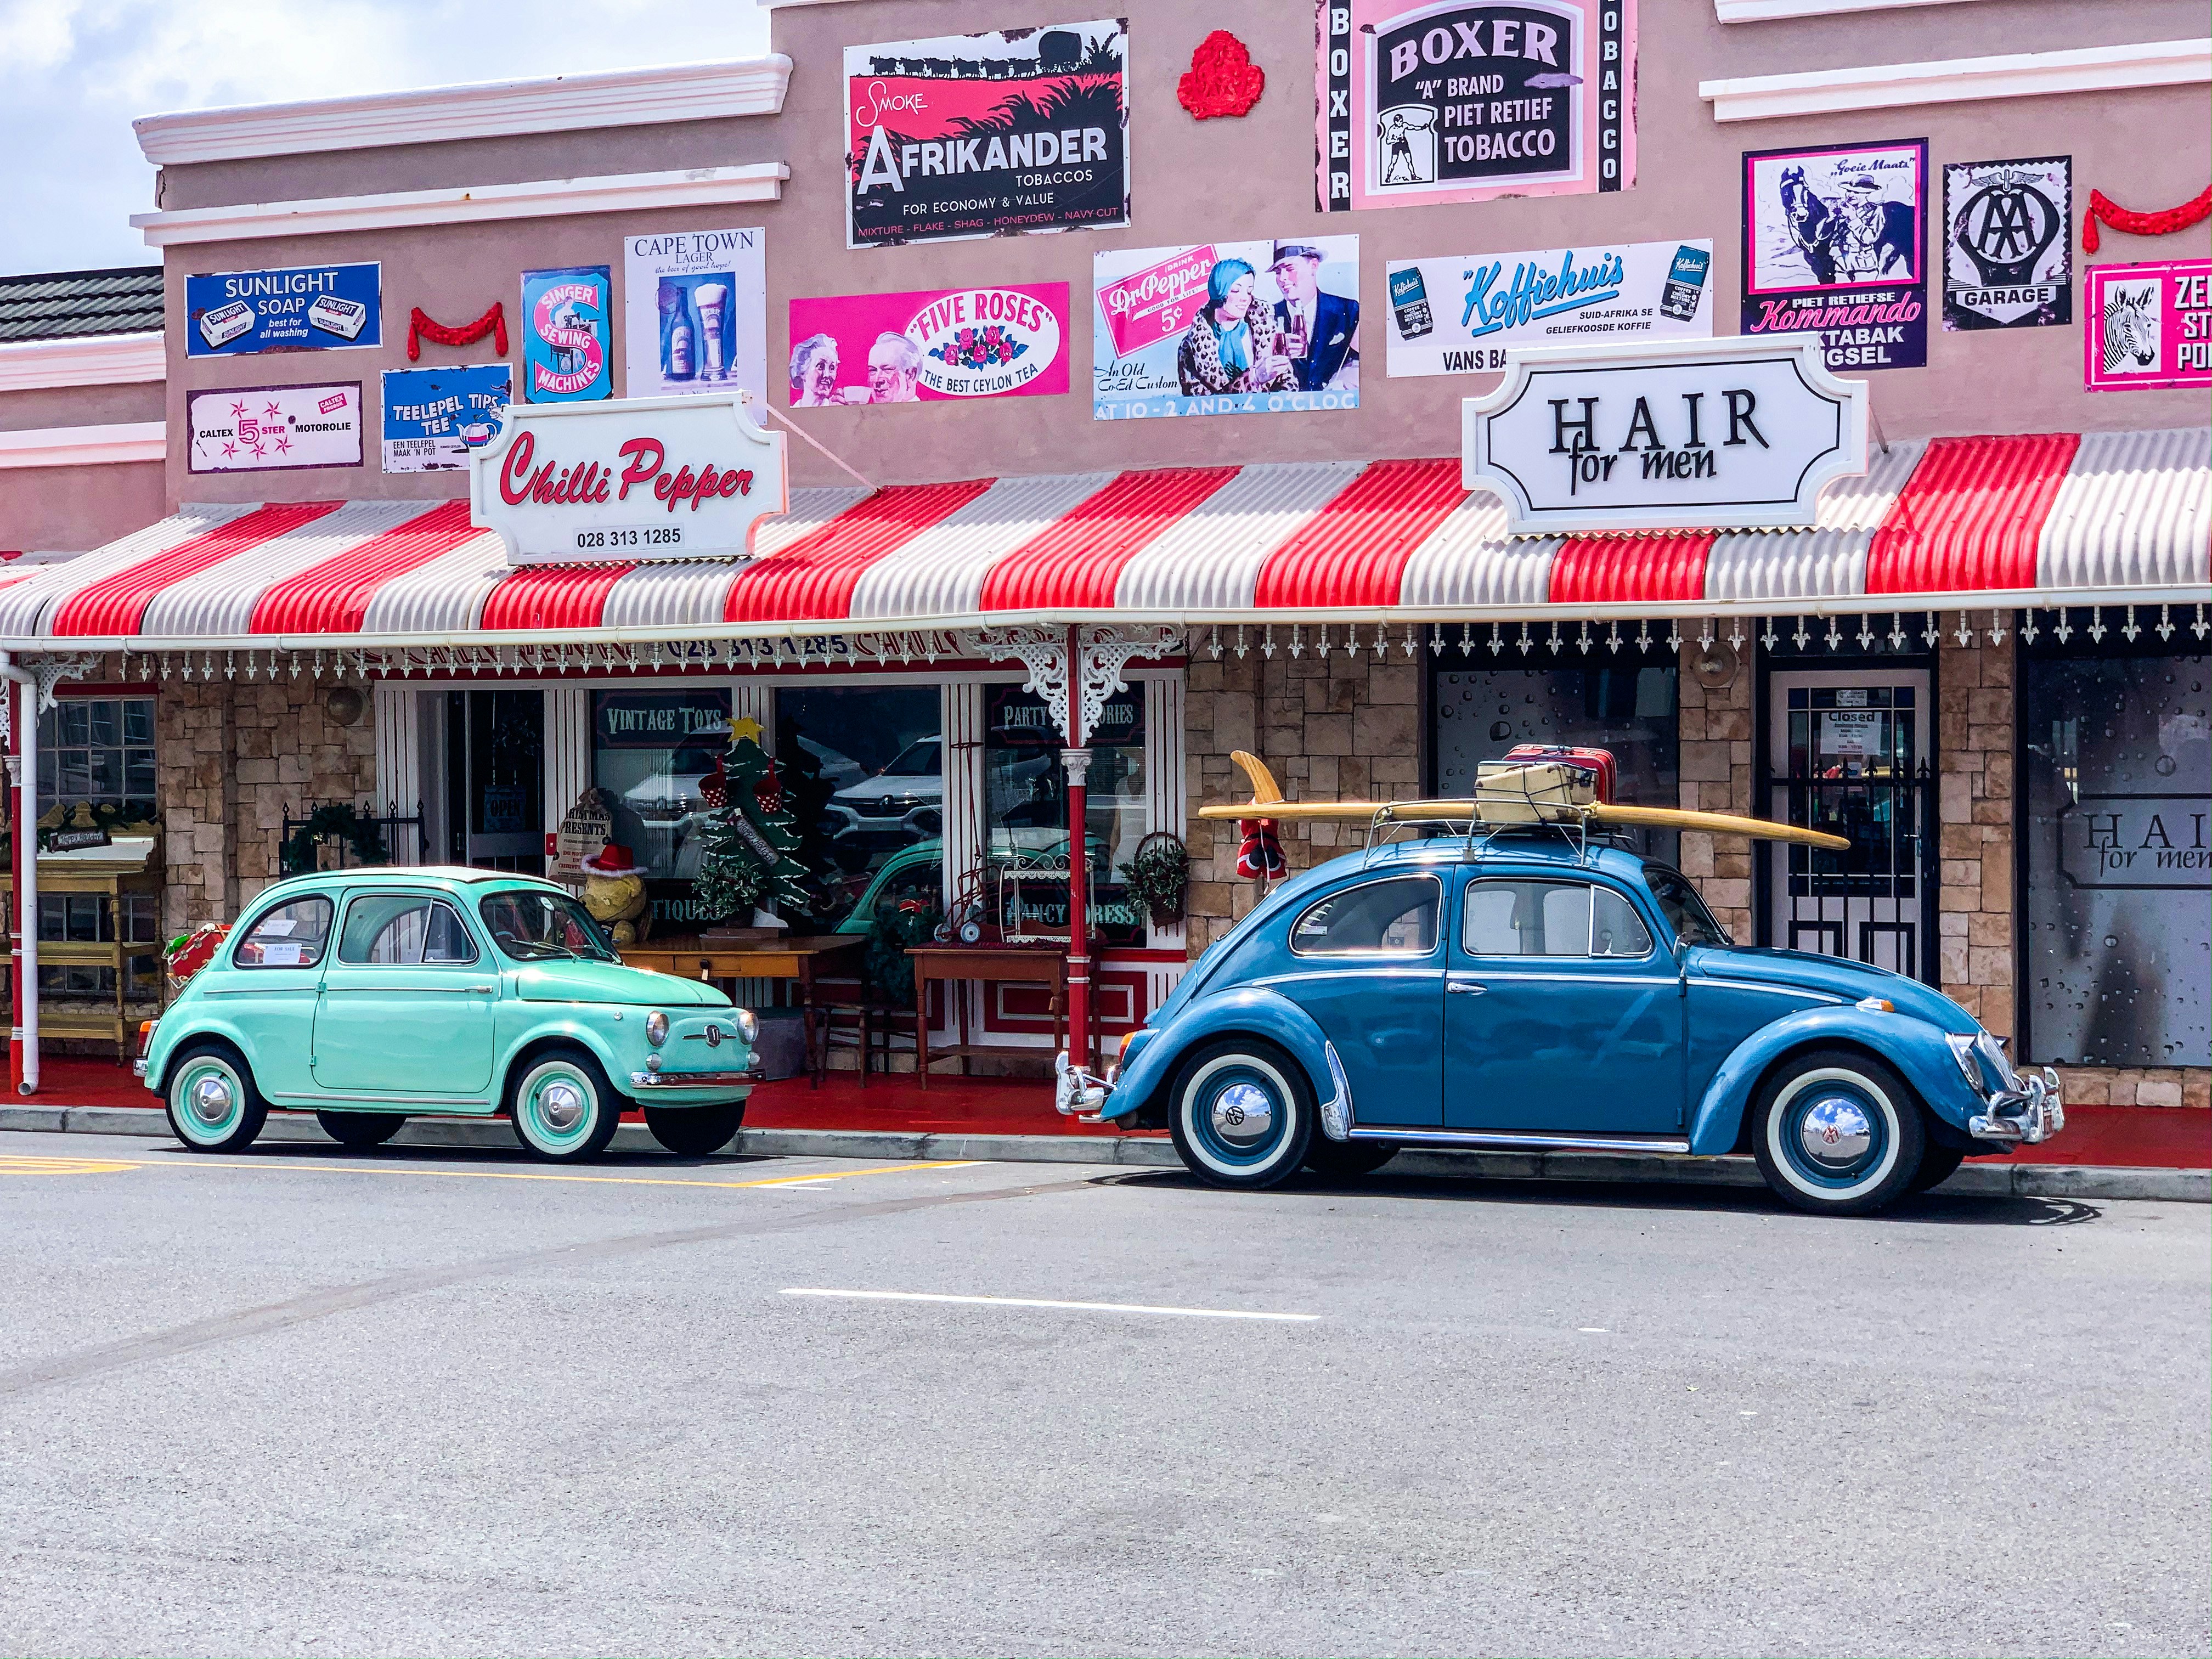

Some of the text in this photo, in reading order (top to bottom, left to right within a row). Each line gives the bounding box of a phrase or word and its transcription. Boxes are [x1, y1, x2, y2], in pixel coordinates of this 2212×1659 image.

[1390, 20, 1559, 82] BOXER
[1448, 75, 1504, 98] BRAND
[1603, 0, 1619, 179] OBACCO
[856, 81, 928, 127] SMOKE
[1331, 8, 1350, 199] BOXER
[1444, 98, 1553, 128] PIET RETIEF
[1444, 129, 1556, 163] TOBACCO
[857, 125, 1107, 195] AFRIKANDER
[1015, 170, 1093, 188] TOBACCOS
[904, 193, 1054, 216] FOR ECONOMY & VALUE
[858, 207, 1119, 236] MIXTURE FLAKE SHAG HONEYDEW NAVY CUT
[635, 231, 754, 257] CAPE TOWN
[675, 252, 714, 264] LAGER
[225, 272, 338, 298] SUNLIGHT
[1109, 258, 1211, 319] Dr. Pepper
[258, 298, 306, 316] SOAP
[319, 298, 357, 314] SUNLIGHT
[541, 285, 593, 310] SINGER
[1147, 303, 1165, 313] GOOD
[1166, 296, 1180, 305] FOR
[1792, 292, 1897, 309] PIET RETIEFSE
[1963, 289, 2050, 306] GARAGE
[210, 304, 244, 323] SUNLIGHT
[269, 317, 302, 328] best for
[1579, 308, 1654, 320] SUID-AFRIKA SE
[1750, 291, 1921, 333] Kommando
[260, 326, 308, 338] all washing
[540, 324, 591, 349] SEWING
[1545, 321, 1652, 335] GELIEFKOOSDE KOFFIE
[1121, 360, 1146, 377] Old
[1442, 350, 1485, 371] VANS
[538, 359, 601, 391] MACHINES
[924, 363, 1039, 393] THE BEST CEYLON TEA
[1135, 375, 1178, 390] Custom
[319, 395, 344, 409] CALTEX
[392, 393, 498, 421] TEELEPEL TIPS
[1166, 400, 1179, 417] 2
[1186, 397, 1233, 417] AND
[200, 419, 352, 444] CALTEX 5 STER MOTOROLIE
[421, 416, 450, 436] TEE
[1548, 388, 1770, 454] HAIR
[393, 441, 405, 449] EEN
[407, 439, 436, 449] TEELEPEL
[393, 449, 411, 457] MAAK
[424, 448, 436, 456] POT
[499, 431, 754, 514] Chilli Pepper
[1568, 431, 1717, 496] for men
[577, 528, 681, 549] 028 313 1285
[606, 706, 722, 734] VINTAGE TOYS
[1003, 705, 1048, 730] PARTY
[1828, 712, 1875, 723] Closed
[490, 799, 521, 817] OPEN
[2098, 836, 2211, 877] for men
